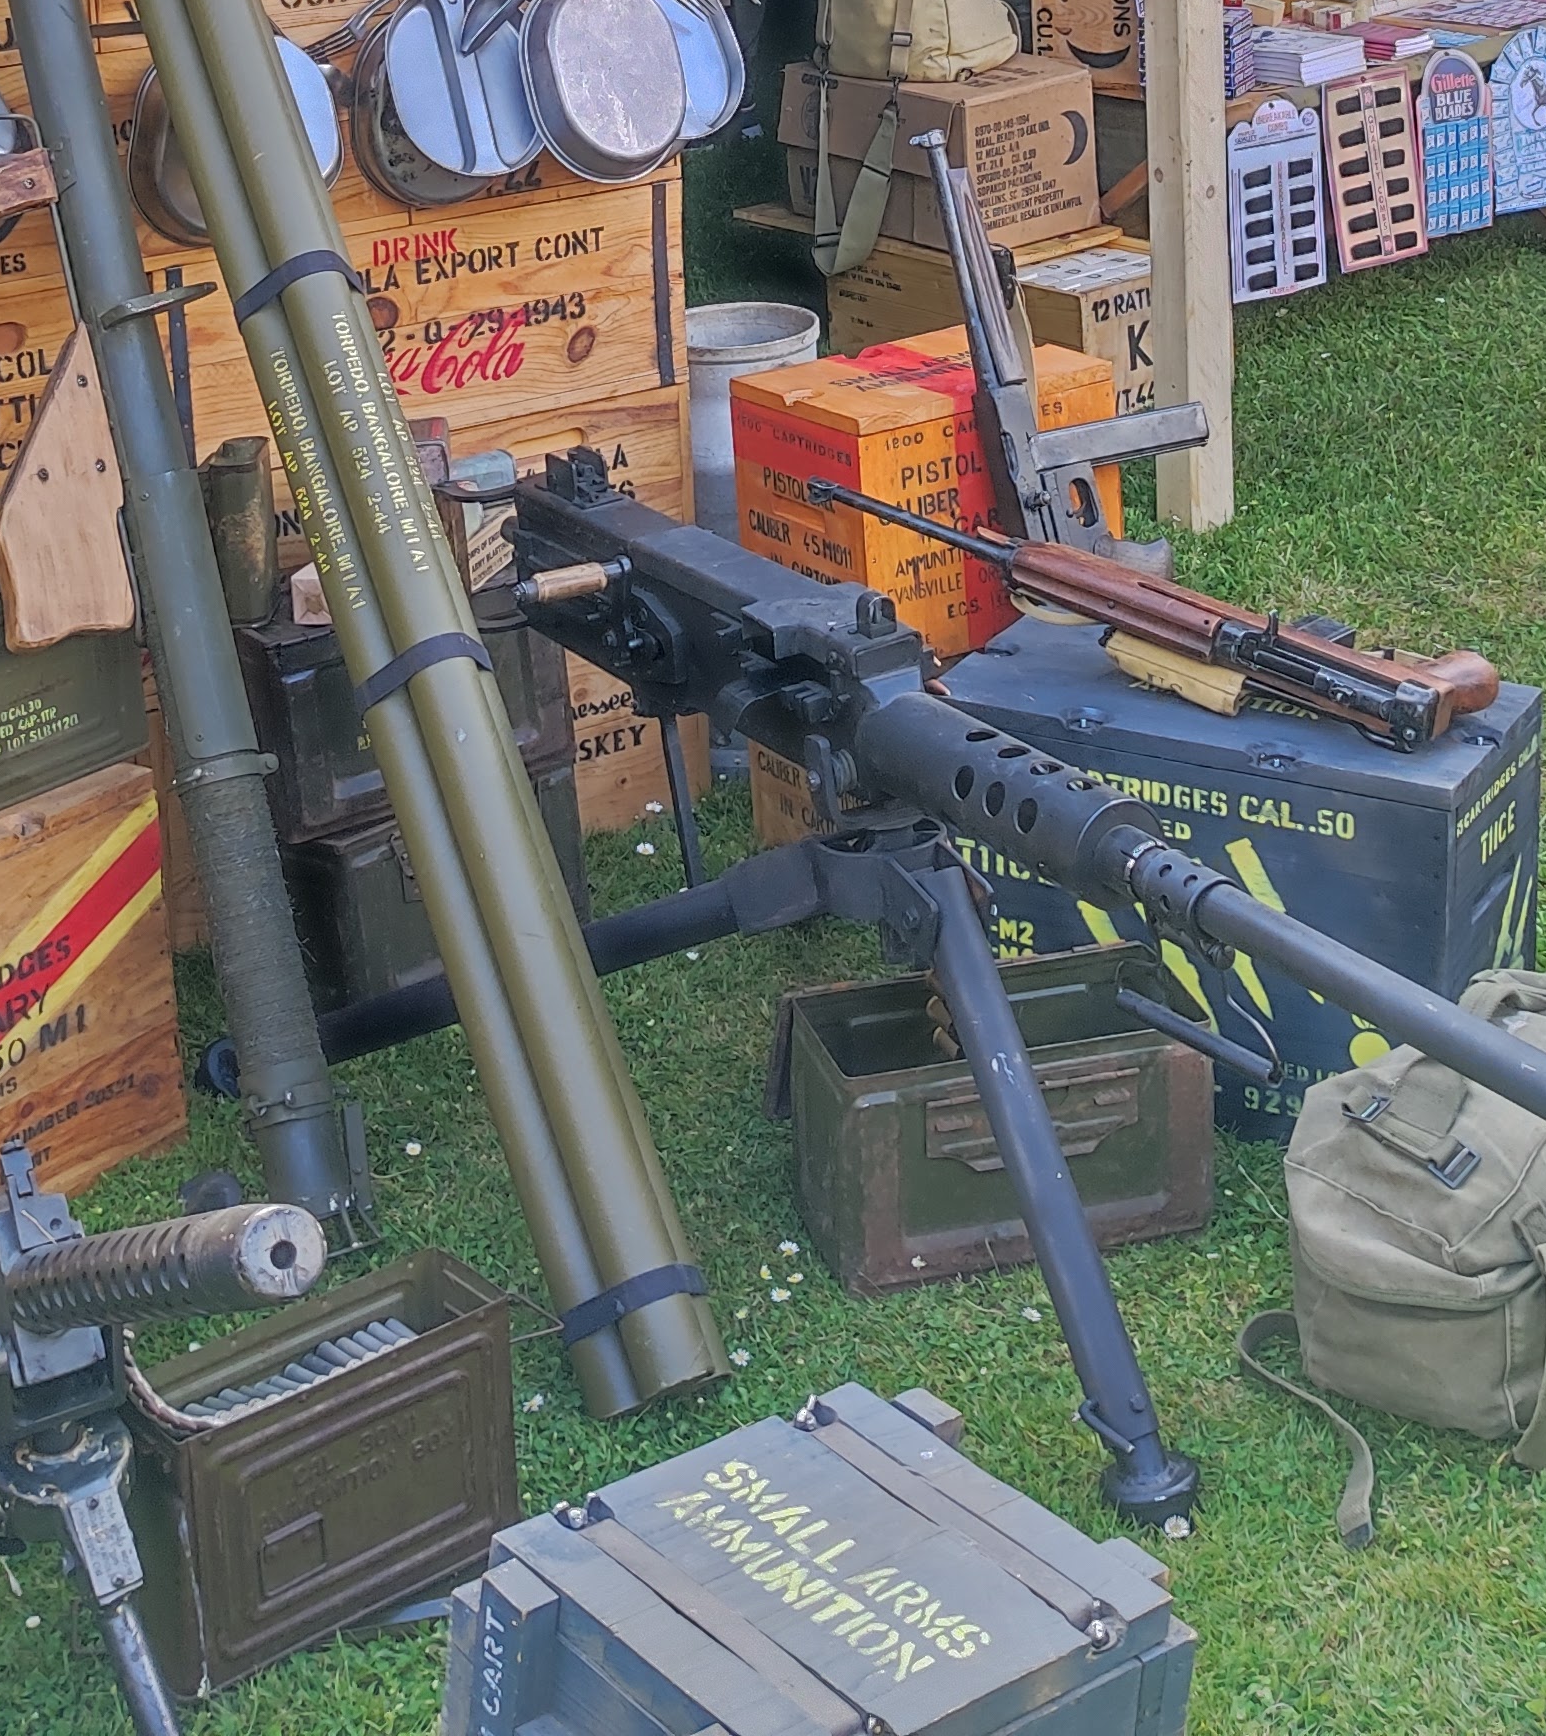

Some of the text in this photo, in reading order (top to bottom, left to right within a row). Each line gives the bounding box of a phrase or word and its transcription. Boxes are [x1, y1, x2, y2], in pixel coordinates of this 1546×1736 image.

[1431, 73, 1476, 93] Gillette
[1436, 88, 1472, 106] BLUE
[1435, 102, 1474, 121] BLADES
[985, 145, 1006, 159] MEALS
[992, 189, 1064, 218] GOVERNMENT PROPERTY
[1020, 196, 1083, 223] RESALE IS UNLAWFUL
[372, 228, 459, 267] DRINK
[415, 225, 605, 285] EXPORT CONT
[1091, 298, 1110, 323] 12
[421, 308, 526, 395] Cola
[1127, 319, 1154, 372] K
[829, 362, 920, 389] SMALL
[331, 309, 372, 401] TORPEDO,
[360, 400, 410, 521] BANGALORE,
[376, 371, 397, 405] LOT
[392, 417, 409, 443] AP
[270, 346, 347, 554] TORPEDO, BANGALORE,
[322, 359, 394, 535] LOT AP 524 2-44
[773, 426, 853, 467] CARTRIDGES
[266, 400, 288, 436] LOT
[309, 532, 331, 574] 2-44
[763, 466, 807, 502] PISTOL
[901, 453, 982, 490] PISTOL
[748, 508, 792, 547] CALIBER
[7, 735, 26, 752] LOT
[757, 750, 802, 789] CALIBER
[779, 792, 795, 820] IN
[38, 1003, 88, 1052] M1
[702, 1456, 991, 1661] SMALL ARMS
[654, 1490, 938, 1684] AMMUNITION
[481, 1604, 506, 1717] CART
